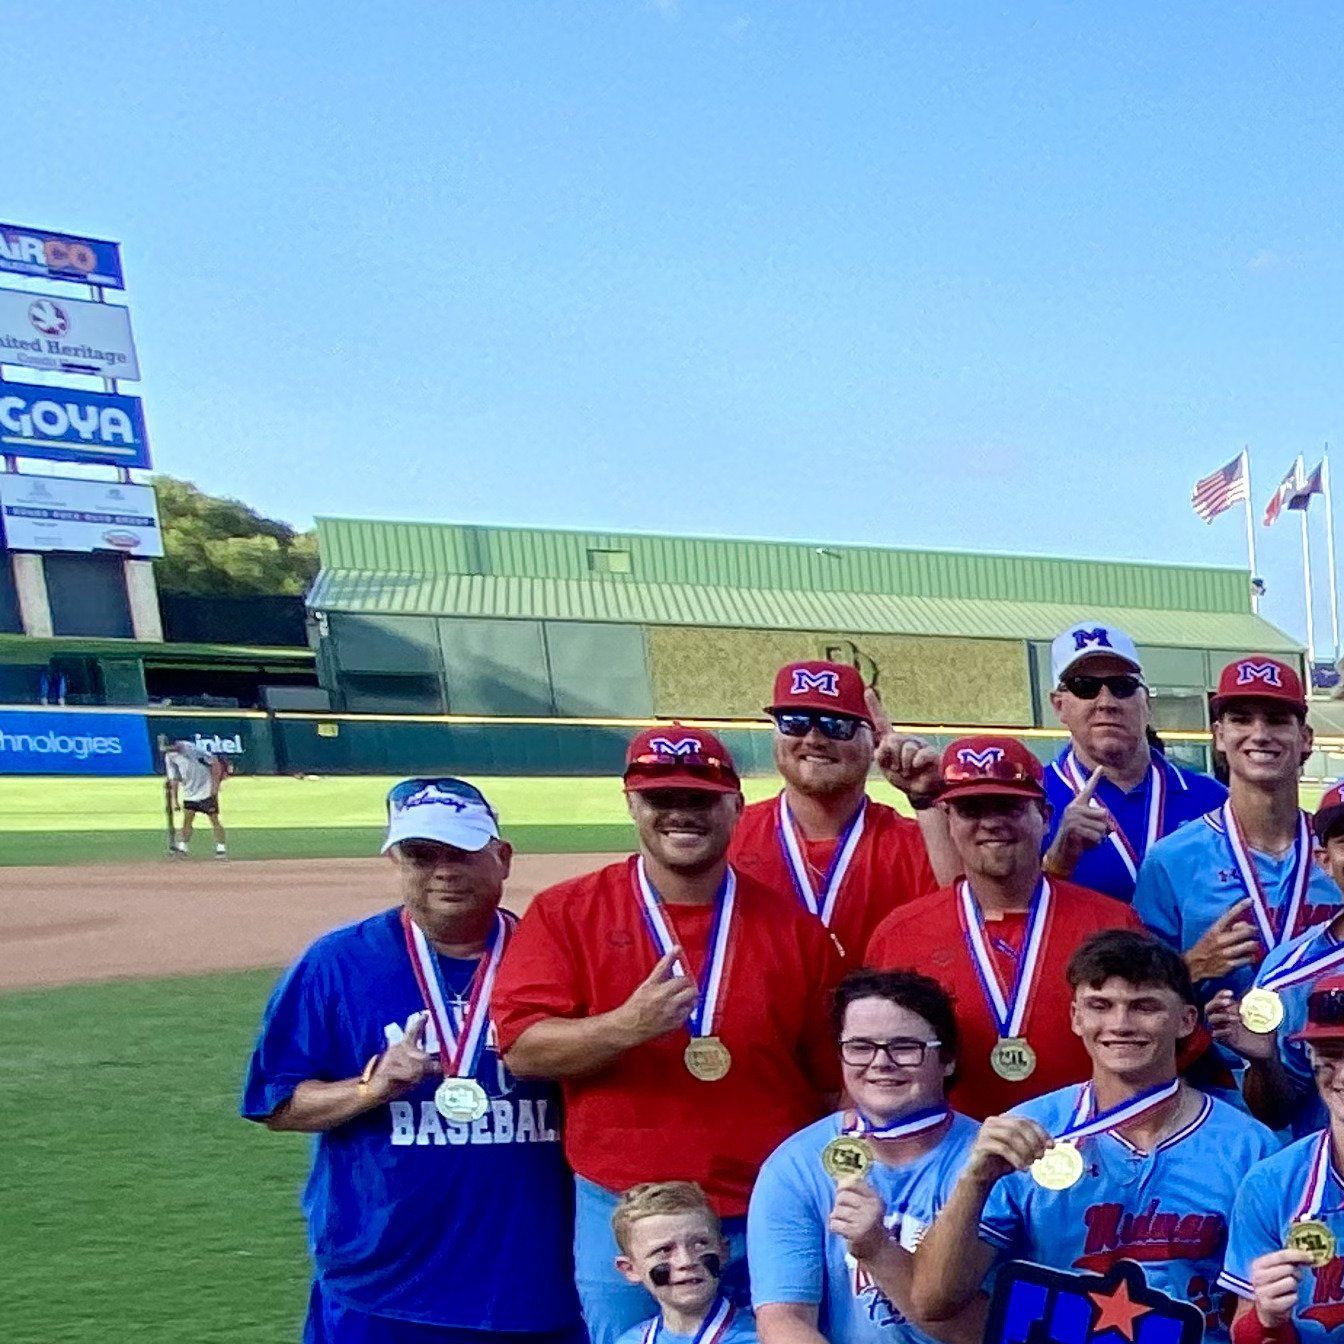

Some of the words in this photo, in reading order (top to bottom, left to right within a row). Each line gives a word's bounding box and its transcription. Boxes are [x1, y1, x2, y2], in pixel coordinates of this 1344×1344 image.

[47, 340, 126, 366] Heritage
[0, 396, 134, 443] GOYA
[1071, 626, 1115, 651] M
[790, 669, 840, 697] M
[1236, 660, 1283, 687] M
